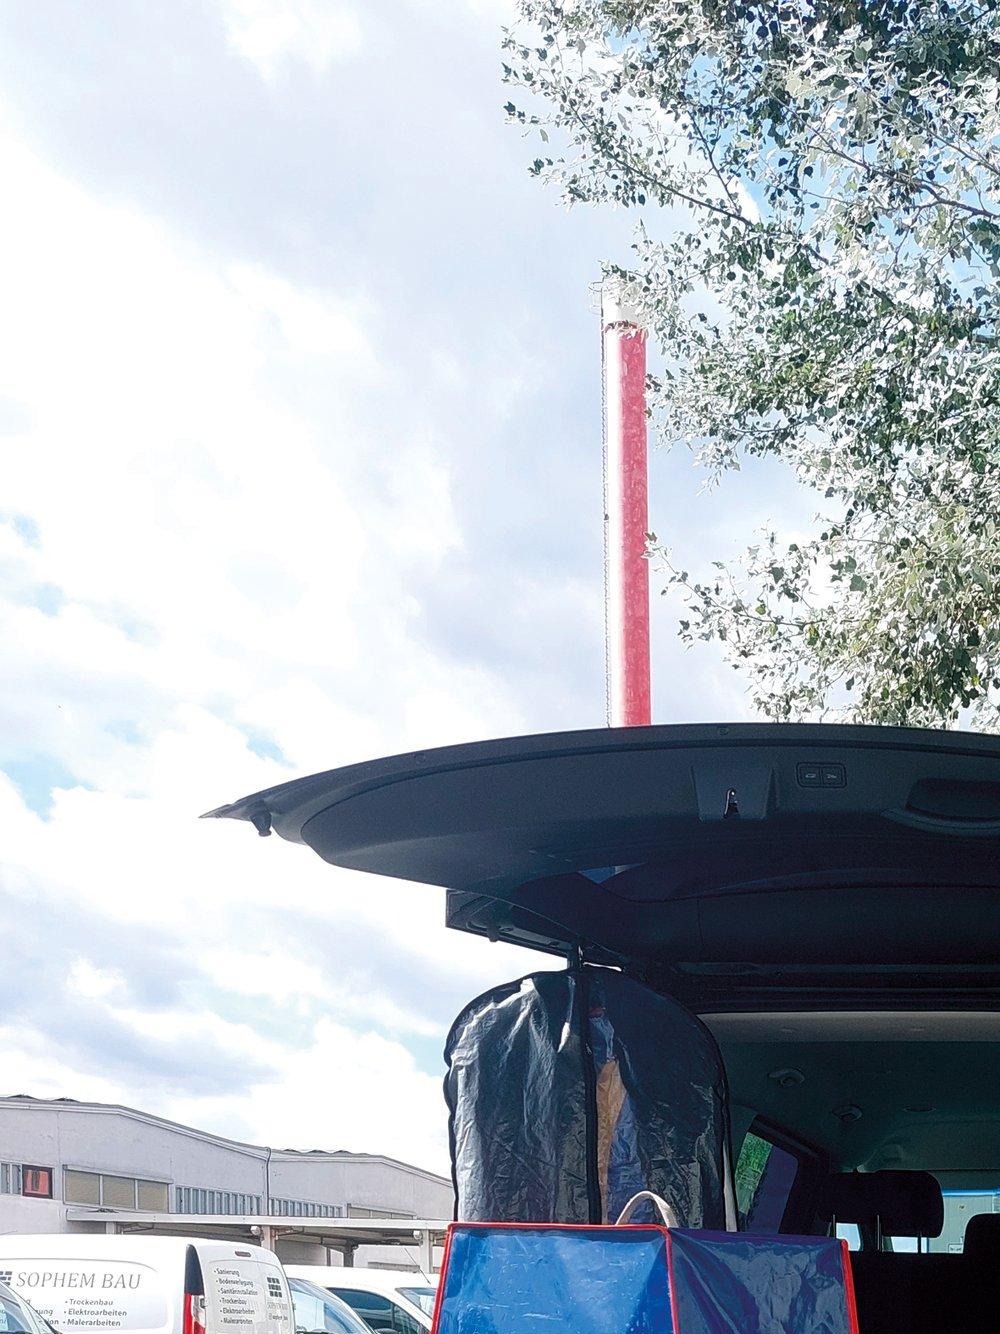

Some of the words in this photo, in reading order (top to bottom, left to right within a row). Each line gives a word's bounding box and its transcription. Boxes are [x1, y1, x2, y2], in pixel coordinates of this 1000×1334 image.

[16, 1271, 96, 1288] SOPHEM
[101, 1273, 142, 1289] BAU
[69, 1298, 114, 1306] Trockenbau
[68, 1308, 128, 1316] Elektroarbeiten
[67, 1318, 121, 1327] Malerarbeiten
